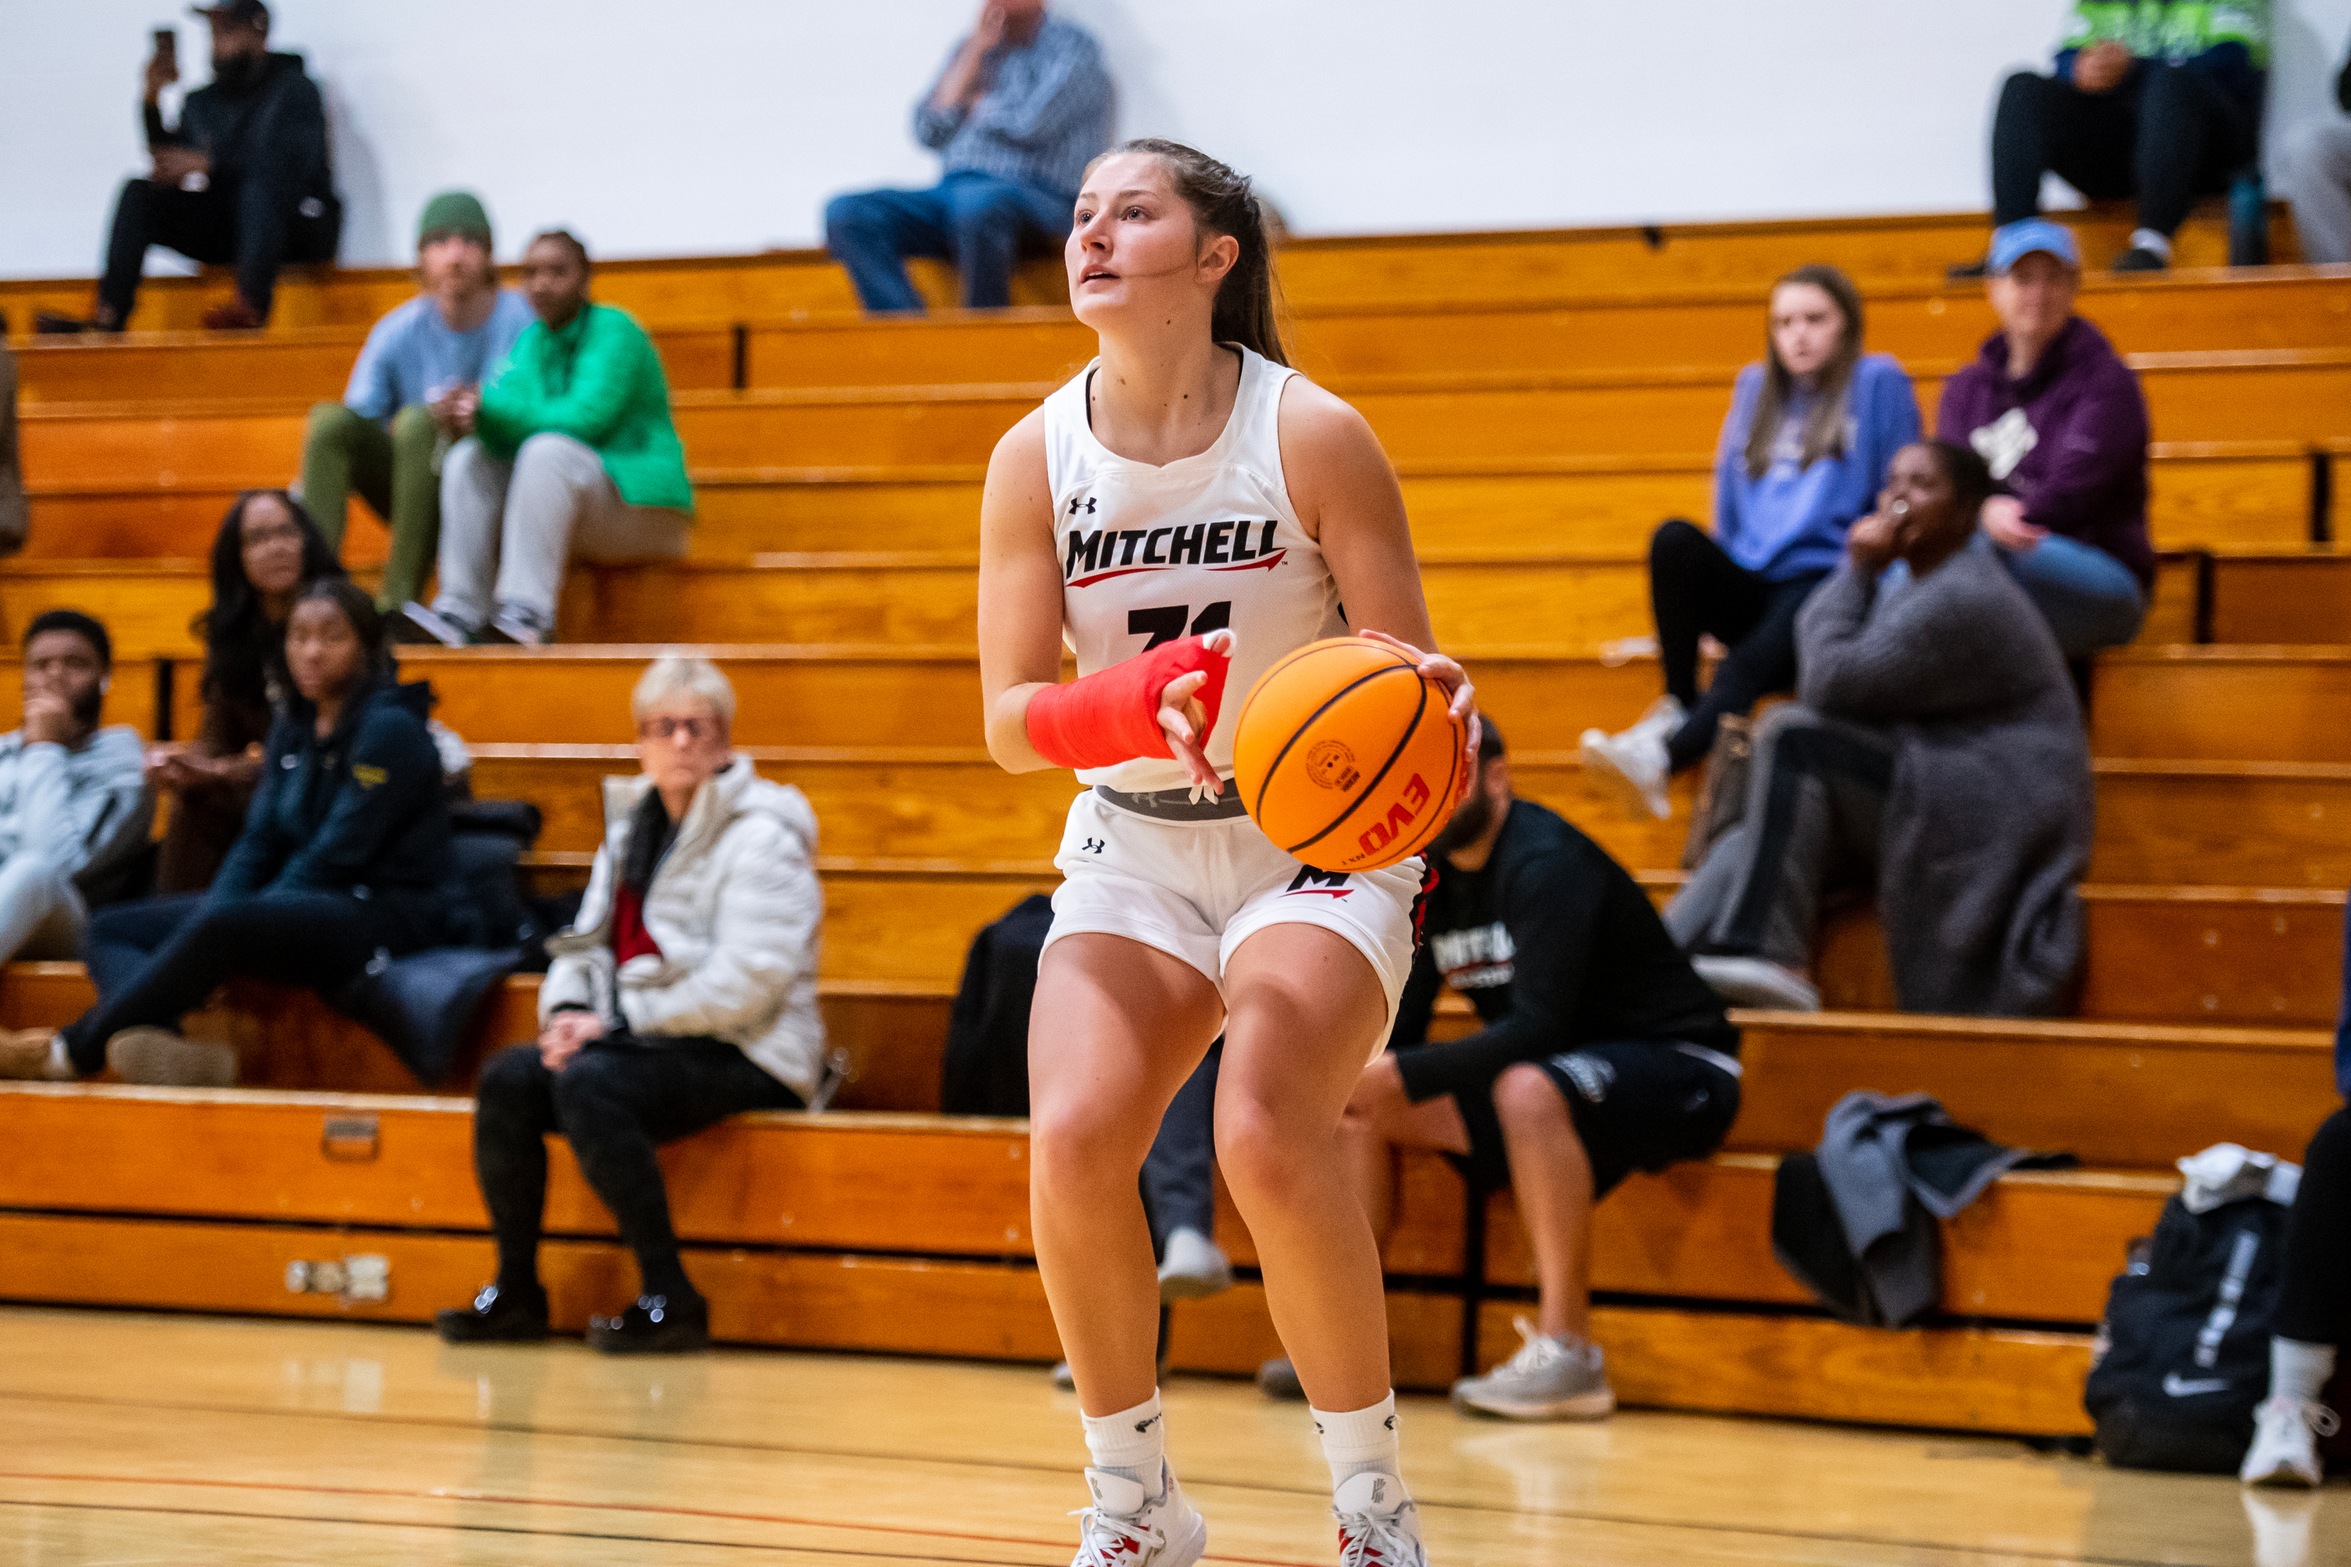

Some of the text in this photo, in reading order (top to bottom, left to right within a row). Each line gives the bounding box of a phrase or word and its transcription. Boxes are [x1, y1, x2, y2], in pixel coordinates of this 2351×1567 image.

[1066, 519, 1287, 580] MITCHELL
[1341, 773, 1430, 866] EVO NXT
